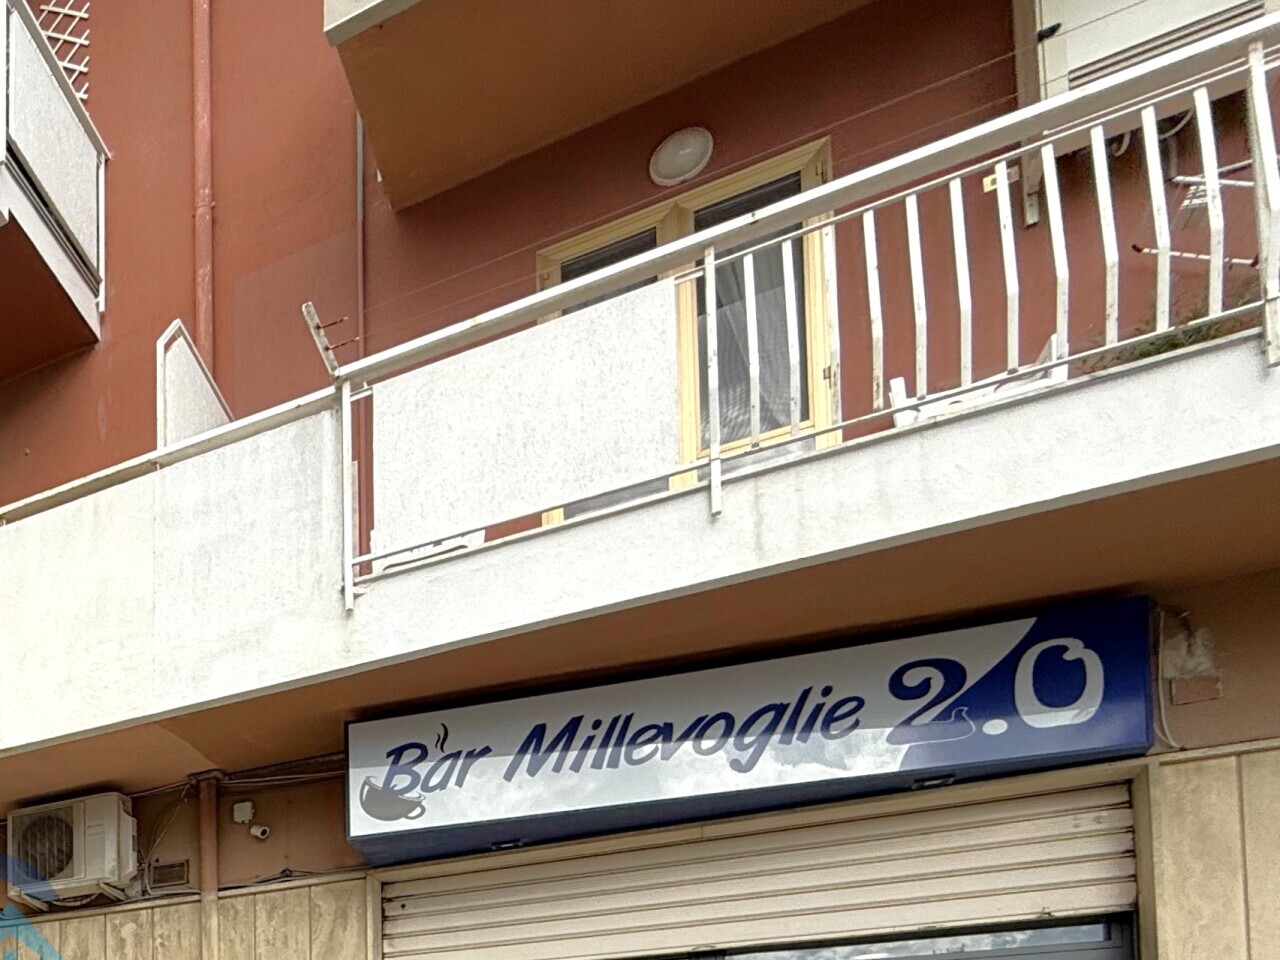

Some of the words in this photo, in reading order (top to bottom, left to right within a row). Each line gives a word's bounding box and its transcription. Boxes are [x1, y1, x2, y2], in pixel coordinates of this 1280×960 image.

[383, 741, 492, 796] Bar
[503, 684, 866, 783] Millevoglie
[885, 637, 1105, 746] 2.0
